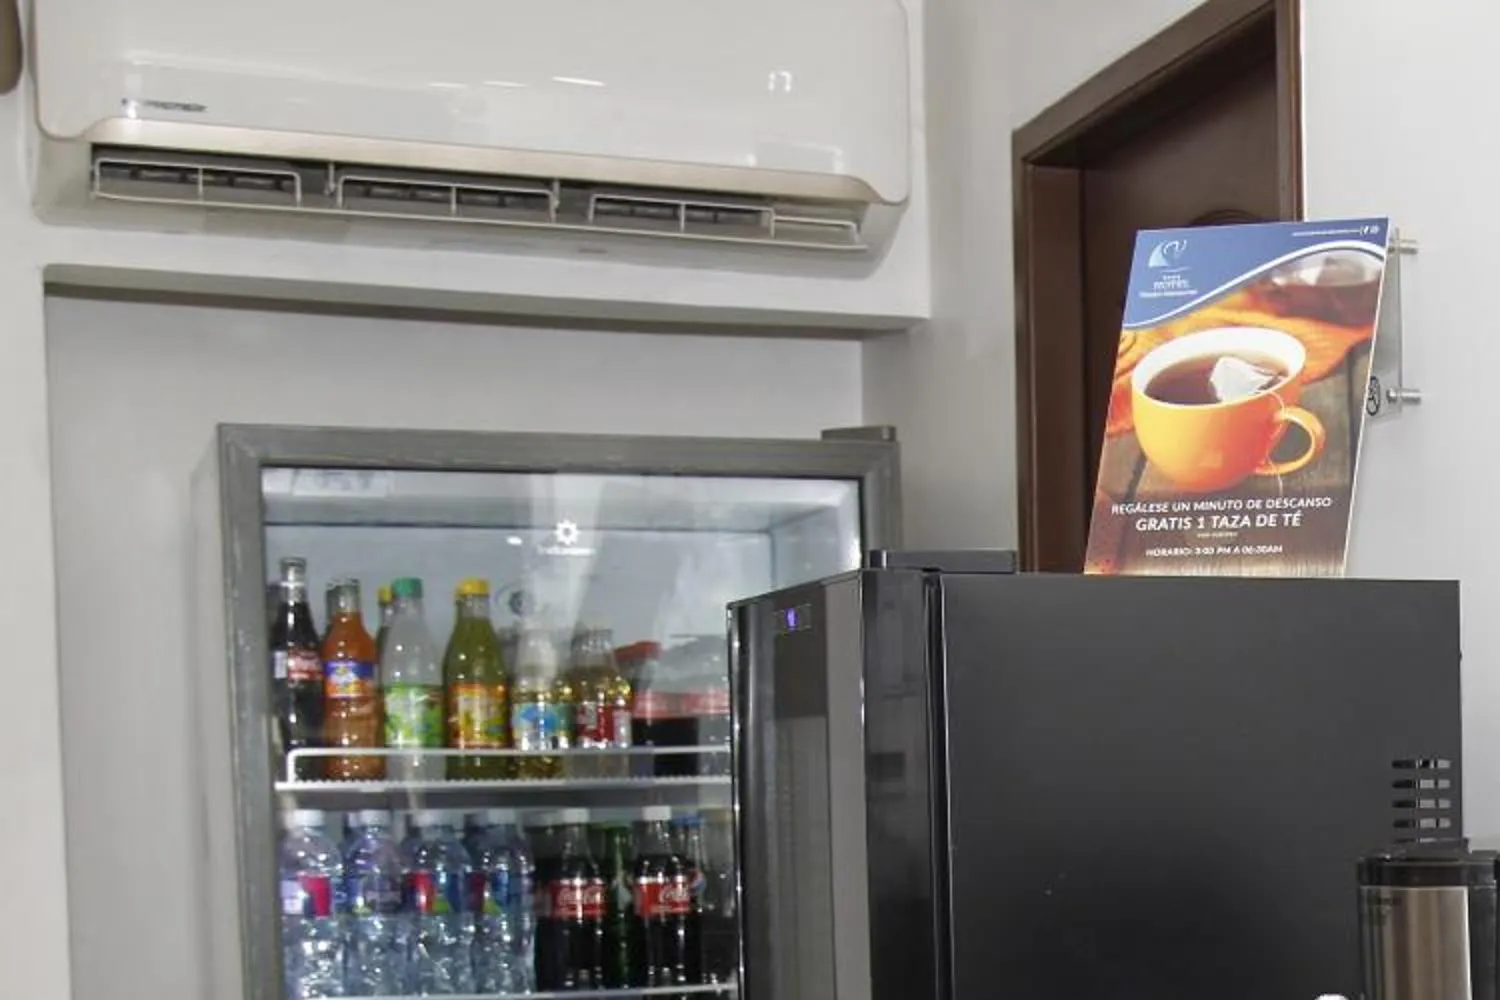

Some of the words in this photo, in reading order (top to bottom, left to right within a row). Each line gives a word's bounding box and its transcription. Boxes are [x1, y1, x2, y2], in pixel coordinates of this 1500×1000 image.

[1111, 501, 1169, 514] REGÁLESE
[1171, 501, 1190, 512] UN
[1193, 499, 1243, 511] MINUTO
[1246, 499, 1263, 509] DE
[1265, 497, 1332, 509] DESCANSO
[1135, 517, 1192, 531] GRATIS
[1197, 516, 1205, 529] 1
[1211, 514, 1251, 528] TAZA
[1255, 513, 1278, 527] DE
[1282, 509, 1303, 527] TÉ
